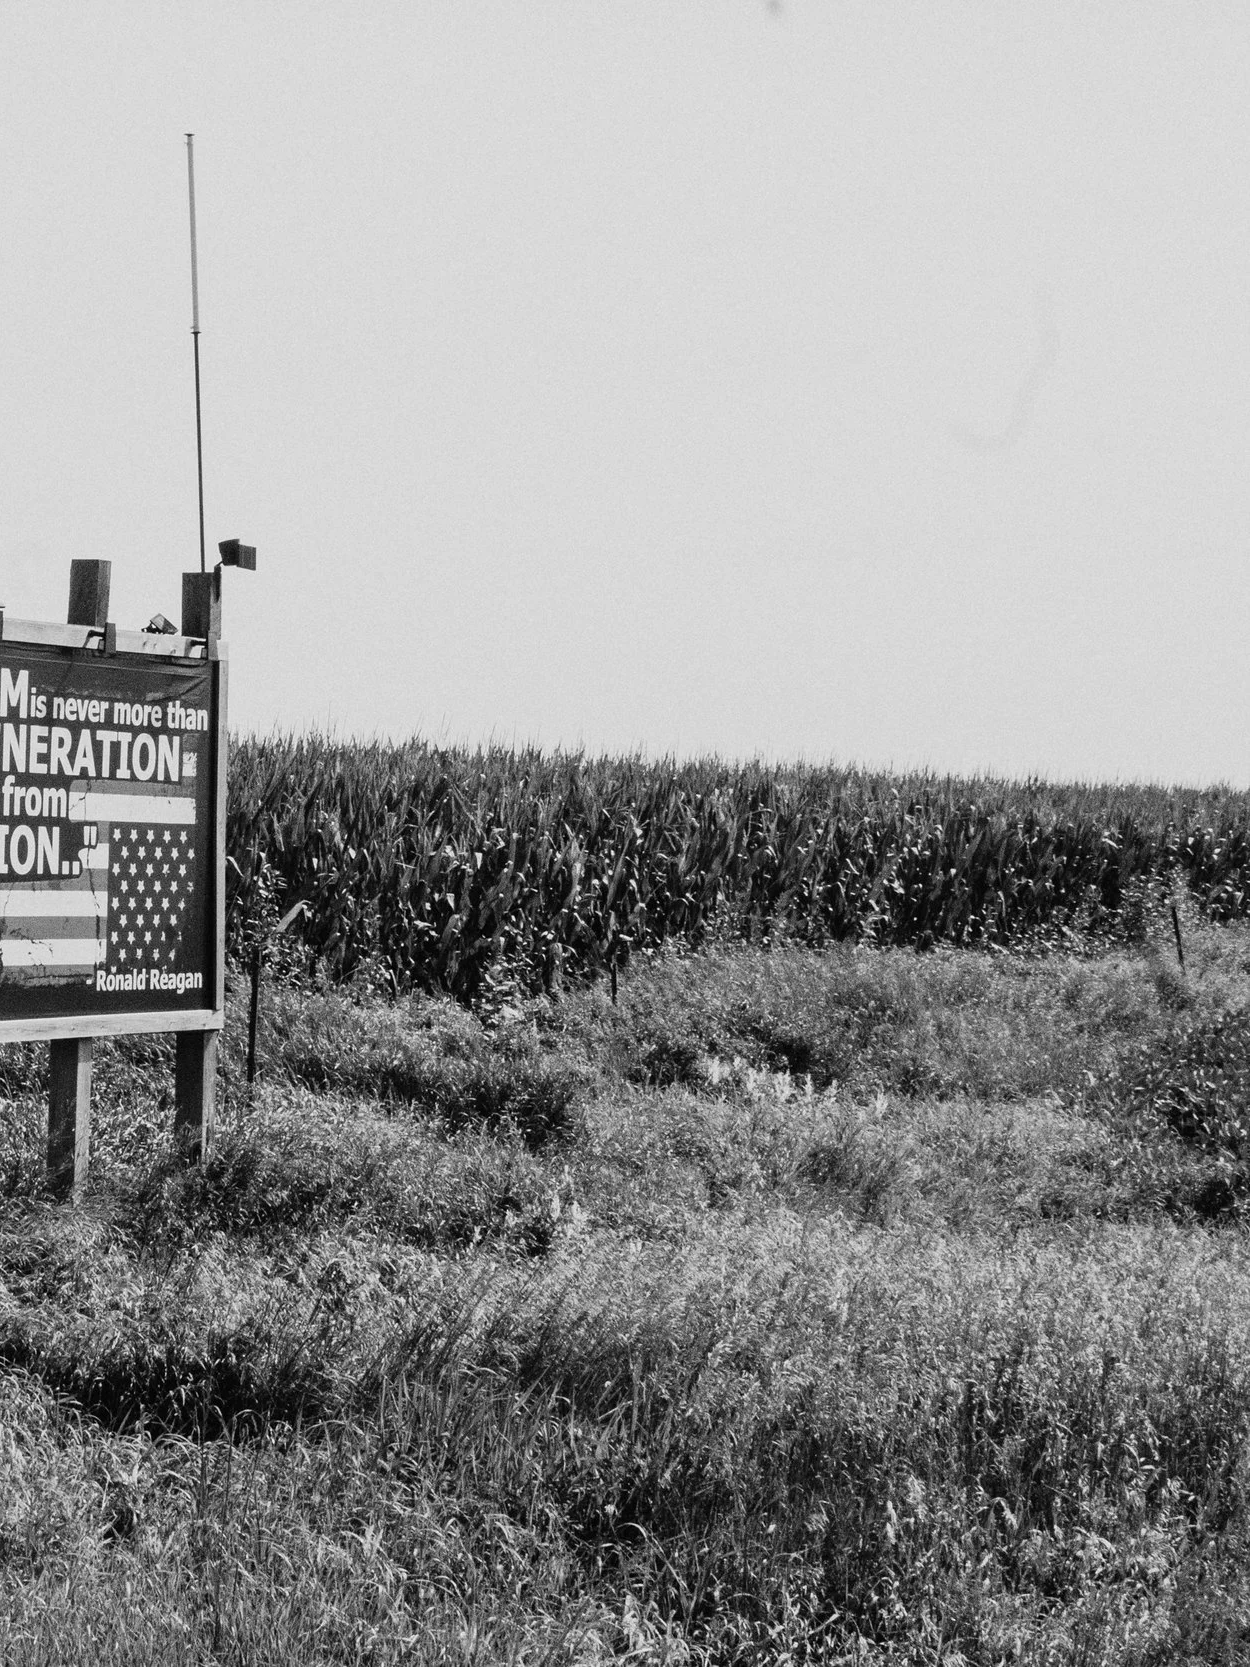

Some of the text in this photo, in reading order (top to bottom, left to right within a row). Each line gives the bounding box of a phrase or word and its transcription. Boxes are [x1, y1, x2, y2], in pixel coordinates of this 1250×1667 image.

[30, 687, 47, 718] is
[53, 695, 109, 724] never
[113, 700, 162, 727] more
[167, 701, 208, 731] than
[2, 775, 67, 818] from
[96, 969, 146, 991] Ronald
[150, 968, 203, 994] Reagan
